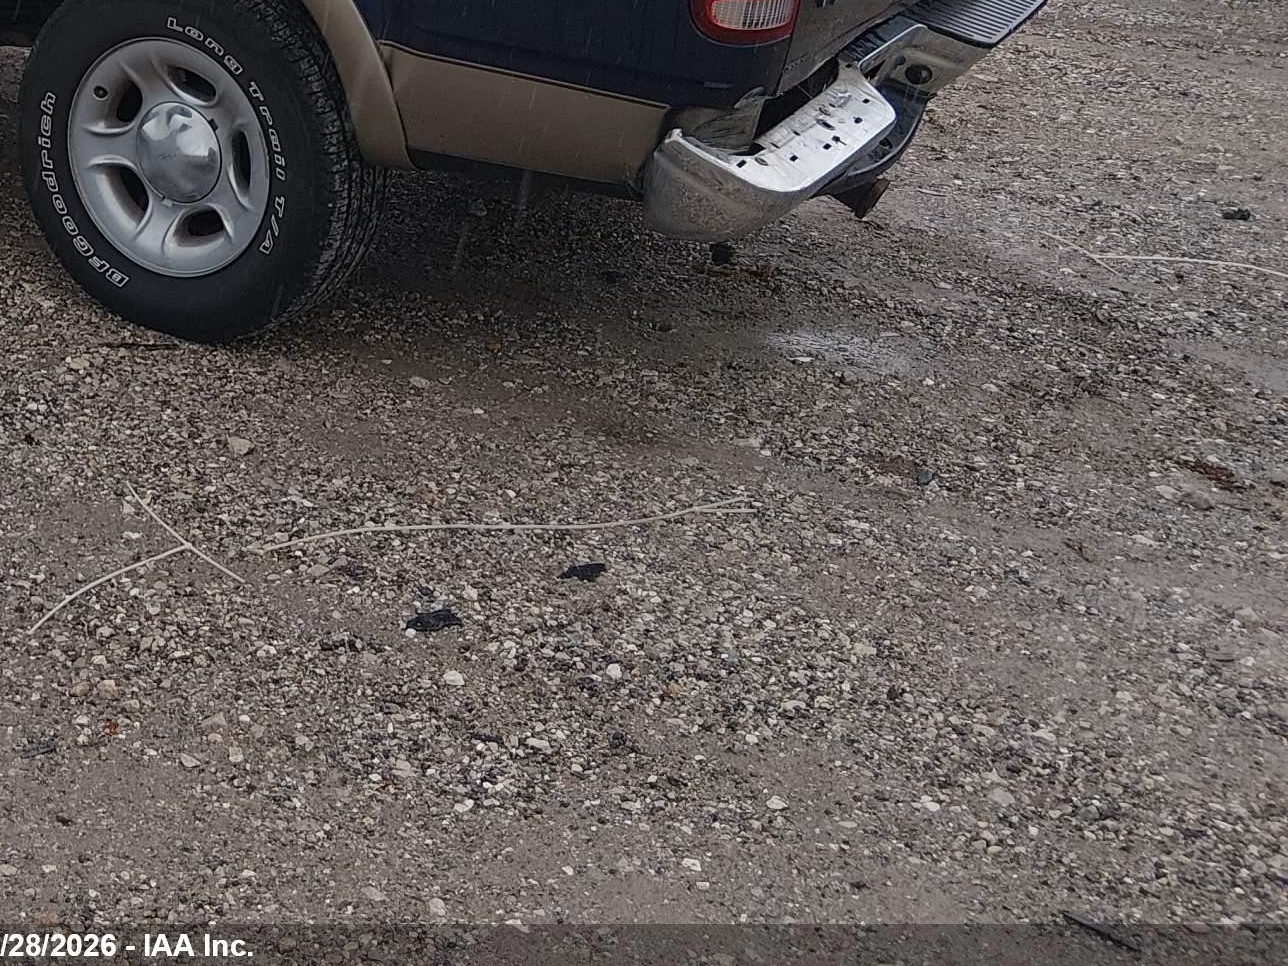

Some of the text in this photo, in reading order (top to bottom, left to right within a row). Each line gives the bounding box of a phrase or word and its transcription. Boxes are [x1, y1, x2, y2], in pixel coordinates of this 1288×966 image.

[37, 91, 129, 288] BFGoodrich
[166, 16, 286, 255] Long Trail T/A
